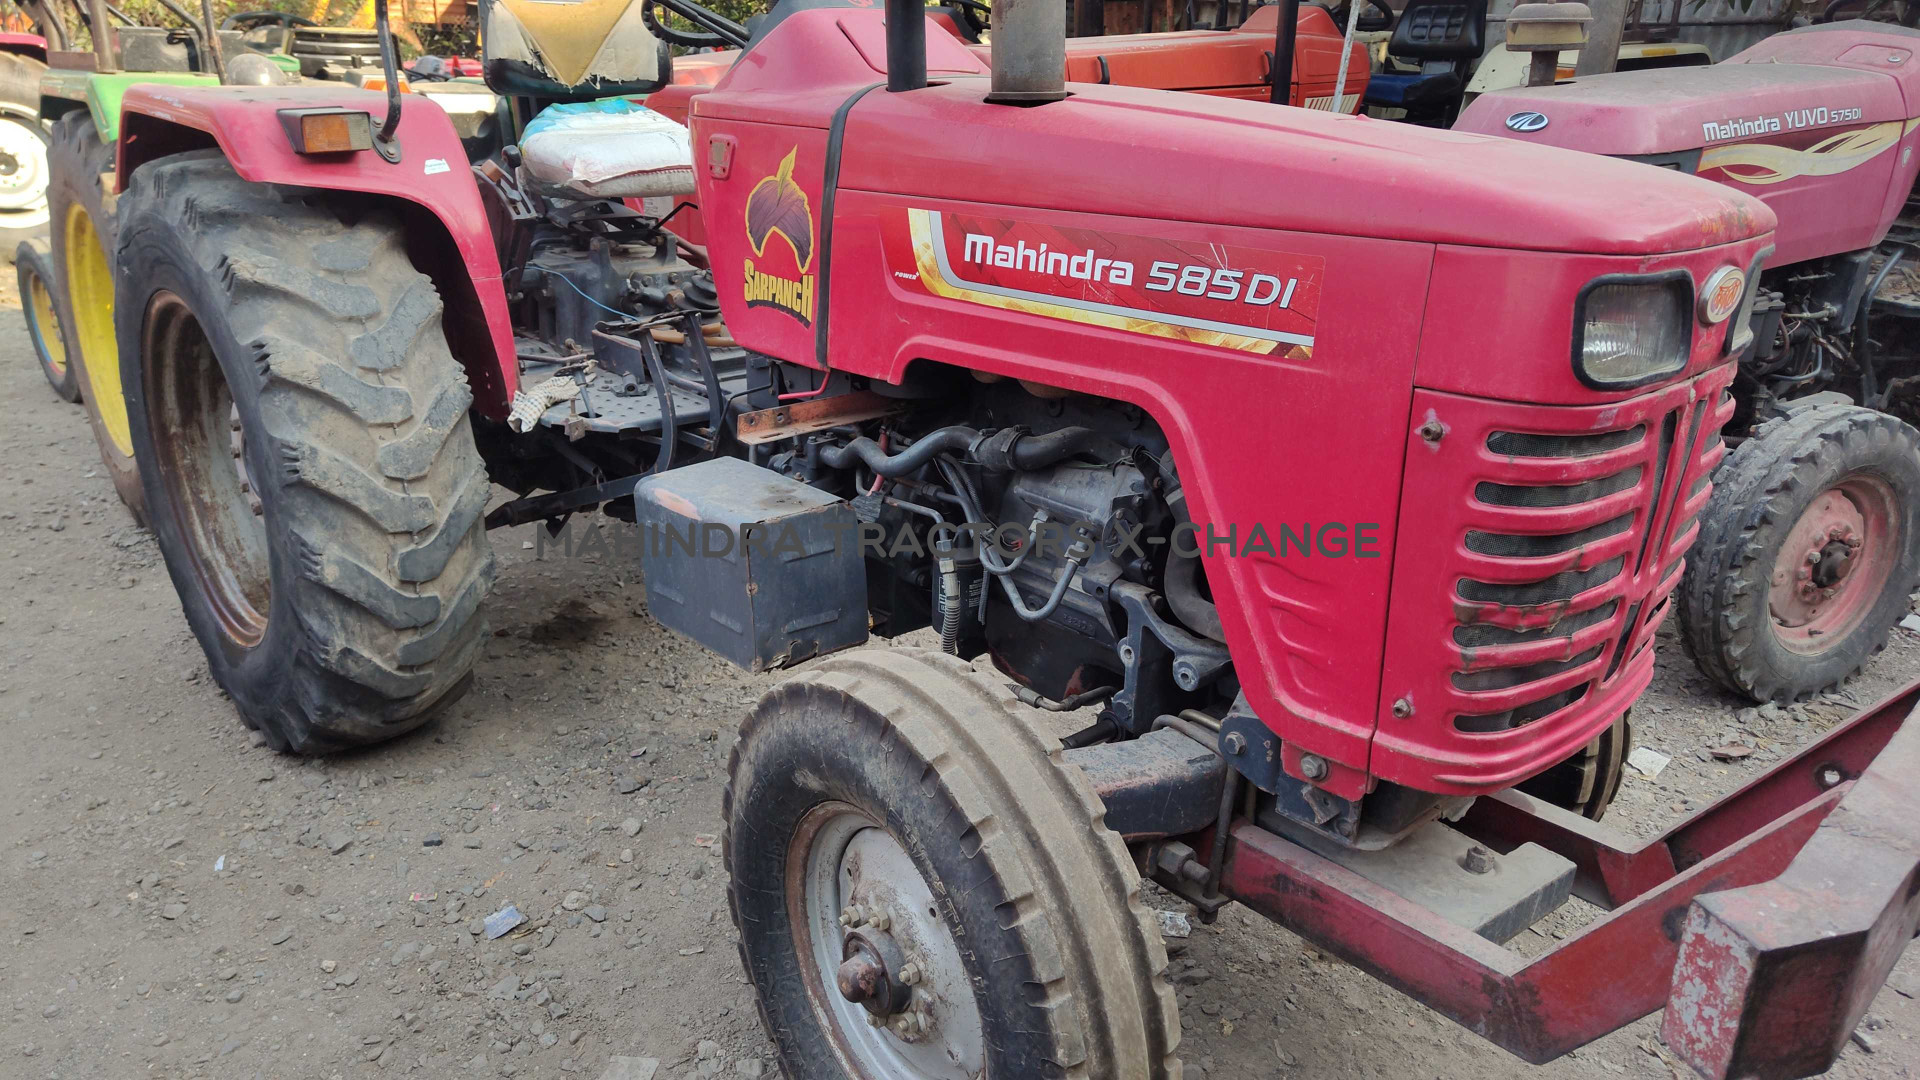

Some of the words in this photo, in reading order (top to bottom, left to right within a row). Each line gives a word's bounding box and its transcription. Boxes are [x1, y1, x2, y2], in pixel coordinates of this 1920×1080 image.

[1702, 115, 1781, 142] Mahindra
[1784, 106, 1828, 129] YUVO
[964, 233, 1134, 286] Mahindra
[744, 258, 814, 323] SARPANCH
